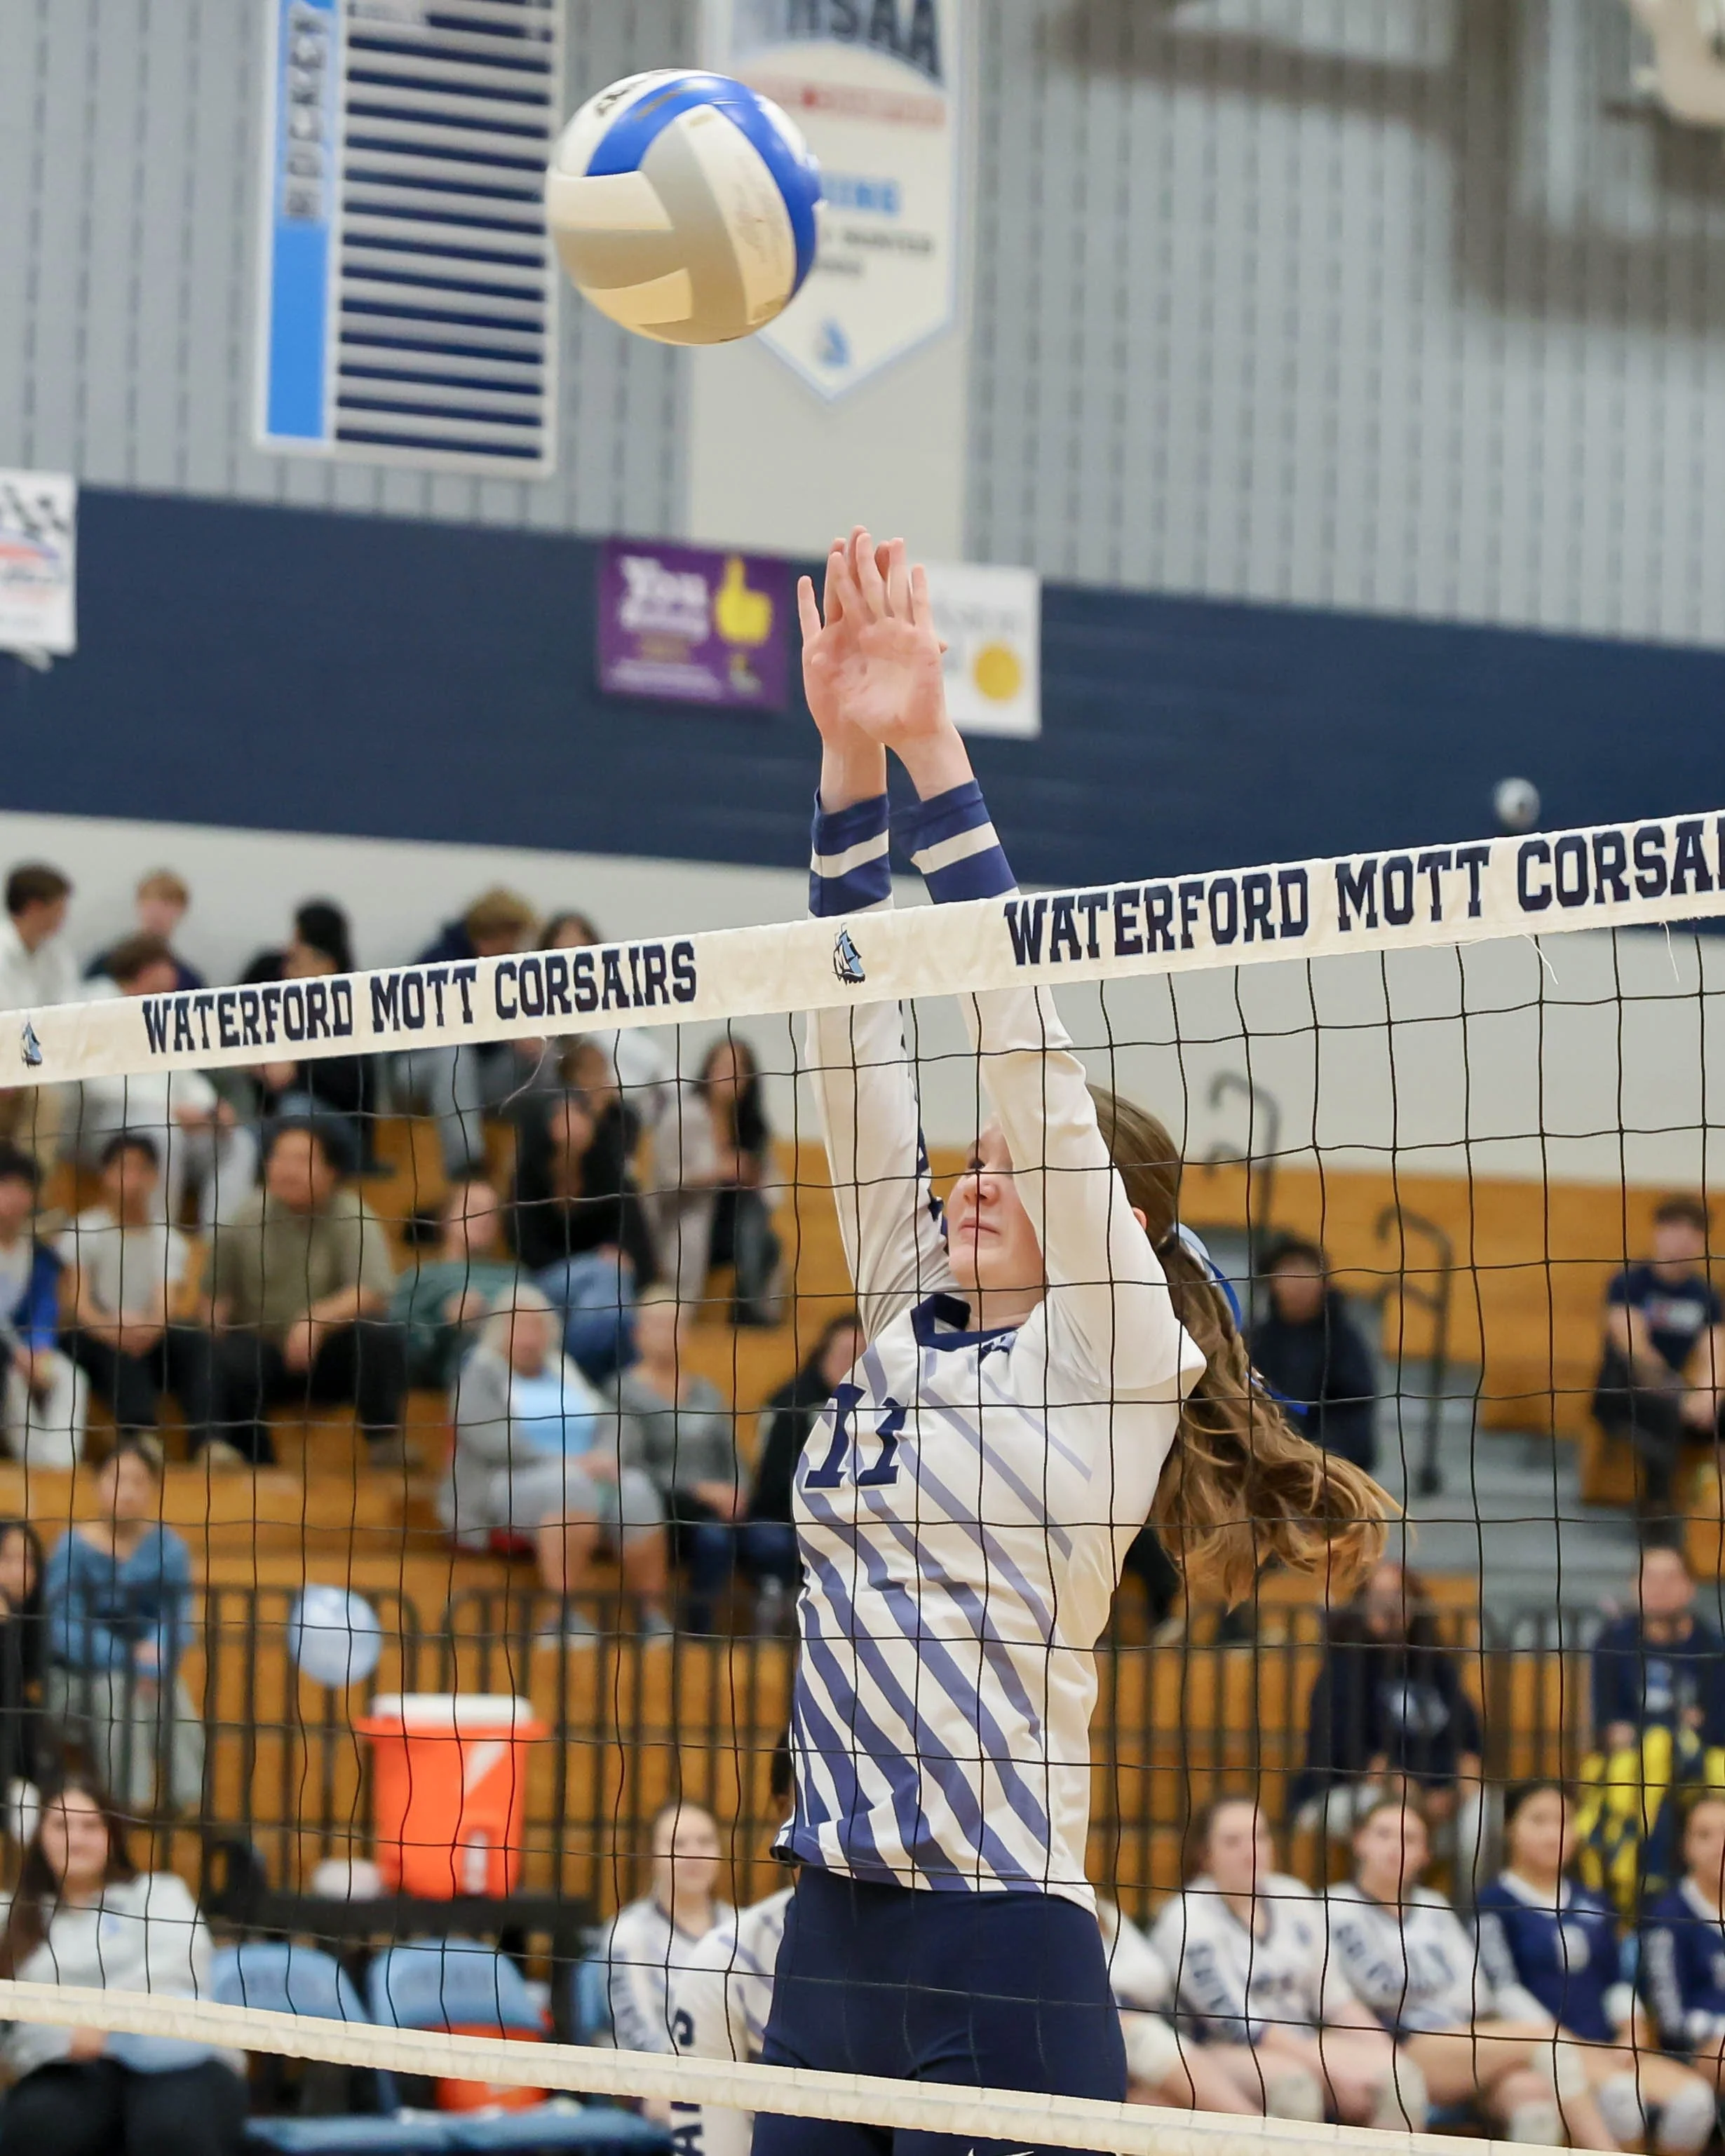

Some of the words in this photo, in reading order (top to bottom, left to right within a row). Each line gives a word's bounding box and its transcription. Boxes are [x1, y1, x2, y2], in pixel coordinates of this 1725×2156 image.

[1003, 867, 1309, 966] WATERFORD
[1334, 846, 1491, 933] MOTT
[142, 979, 353, 1054] WATERFORD
[369, 965, 477, 1033] MOTT
[494, 941, 697, 1021] CORSAIRS
[804, 1383, 909, 1489] 11
